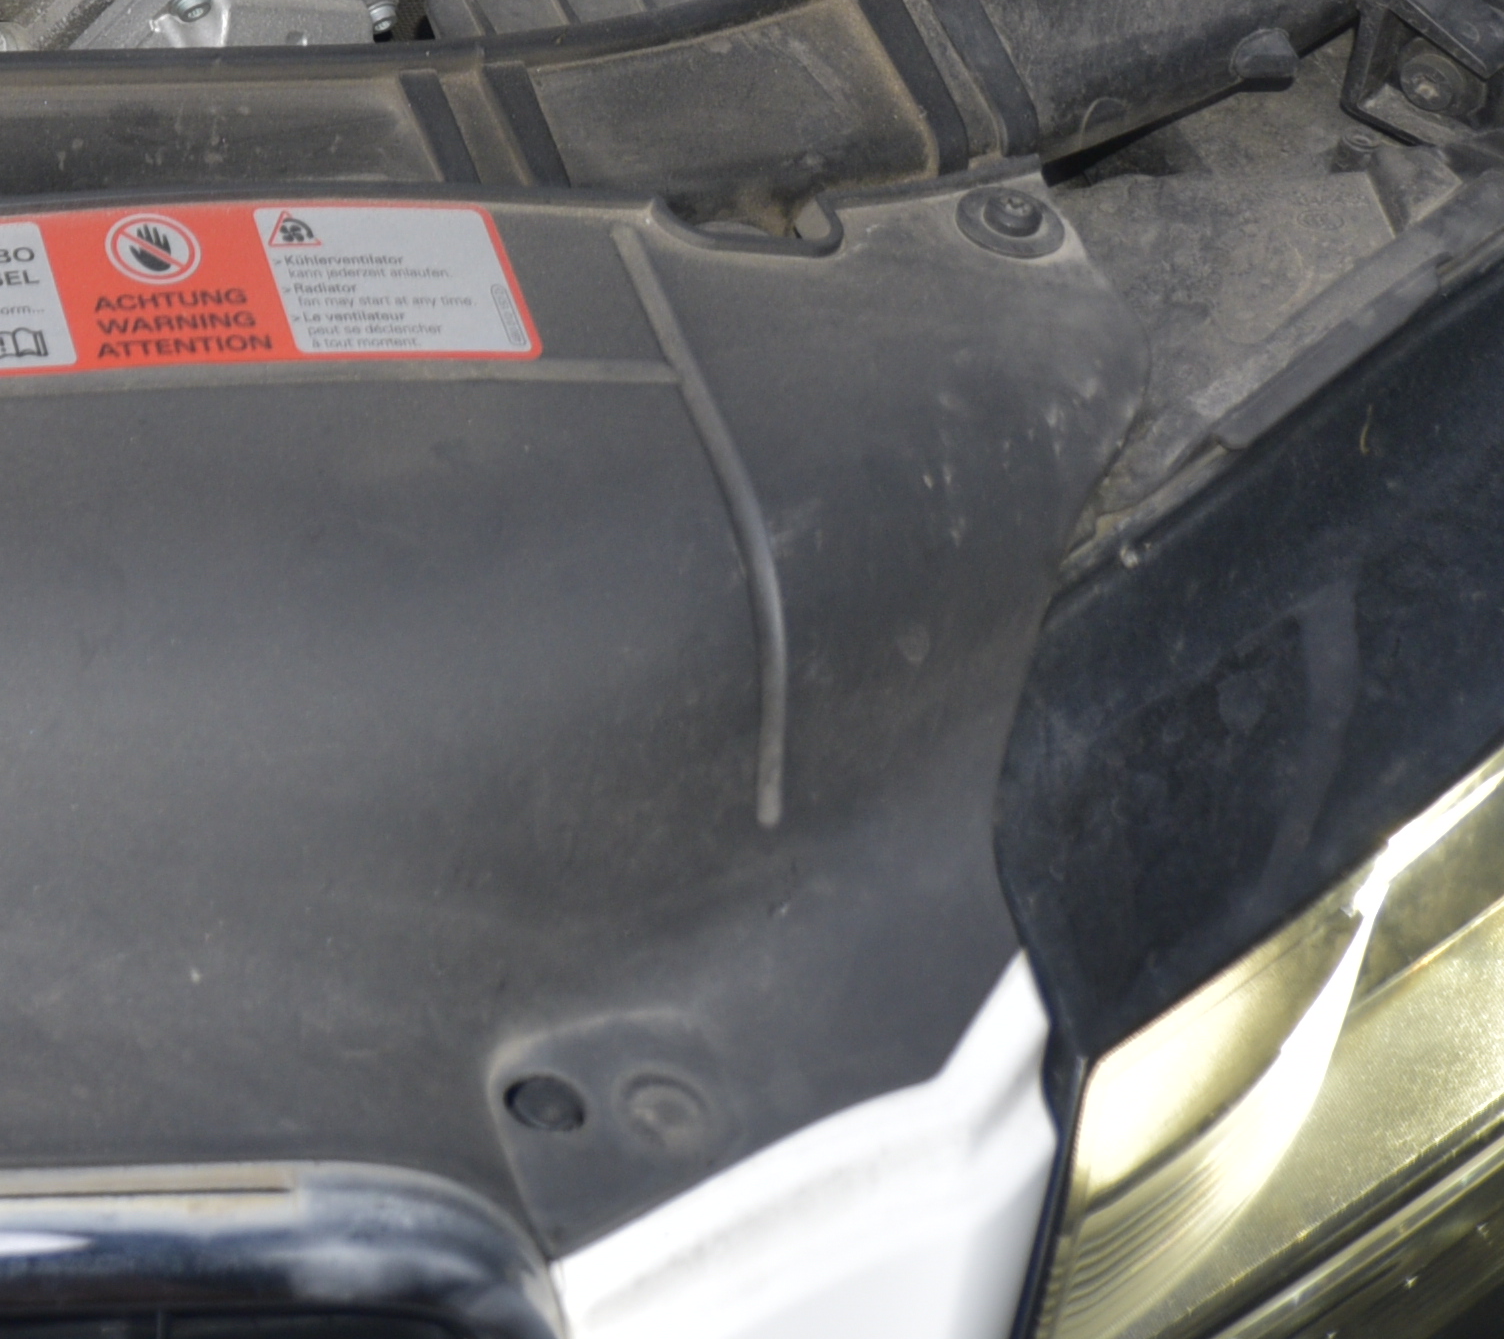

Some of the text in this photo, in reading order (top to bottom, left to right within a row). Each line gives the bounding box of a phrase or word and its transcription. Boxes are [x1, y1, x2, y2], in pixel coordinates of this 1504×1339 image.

[284, 253, 404, 266] Kühlerventilator
[289, 266, 323, 279] kann
[326, 266, 387, 281] jederzeit
[293, 283, 357, 295] Radiator
[94, 287, 248, 313] ACHTUNG
[297, 295, 322, 307] fan
[324, 297, 355, 310] may
[358, 295, 391, 307] start
[394, 296, 409, 307] at
[412, 297, 436, 310] any
[97, 311, 257, 335] WARNING
[303, 311, 406, 323] Le ventilateur
[307, 323, 443, 338] peut se déclencher
[97, 334, 274, 359] ATTENTION
[322, 338, 353, 349] tout
